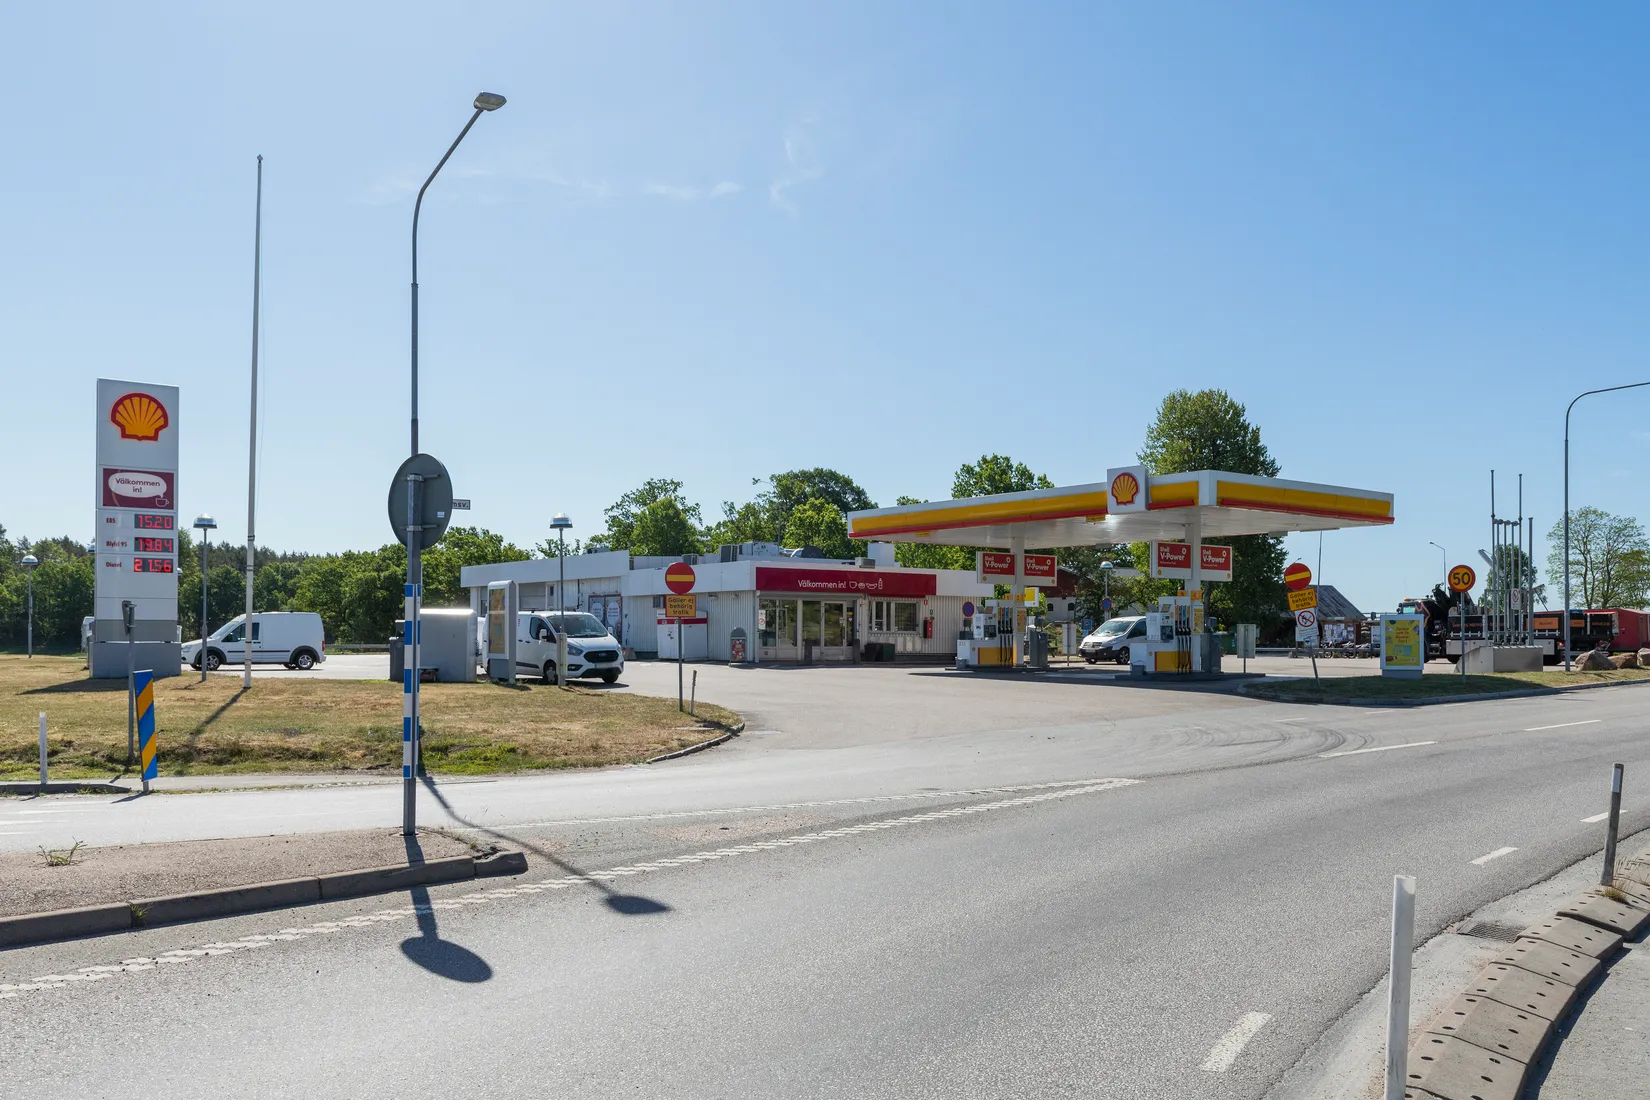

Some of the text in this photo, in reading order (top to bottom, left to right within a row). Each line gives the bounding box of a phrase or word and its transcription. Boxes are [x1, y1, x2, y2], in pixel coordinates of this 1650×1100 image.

[115, 477, 161, 487] Välkommen
[1160, 553, 1185, 561] V-Power
[1202, 555, 1225, 563] V-Power
[985, 561, 1009, 569] V-Power
[1026, 563, 1049, 571] V-Power
[1452, 572, 1471, 586] 50
[797, 579, 846, 589] Välkommen in!
